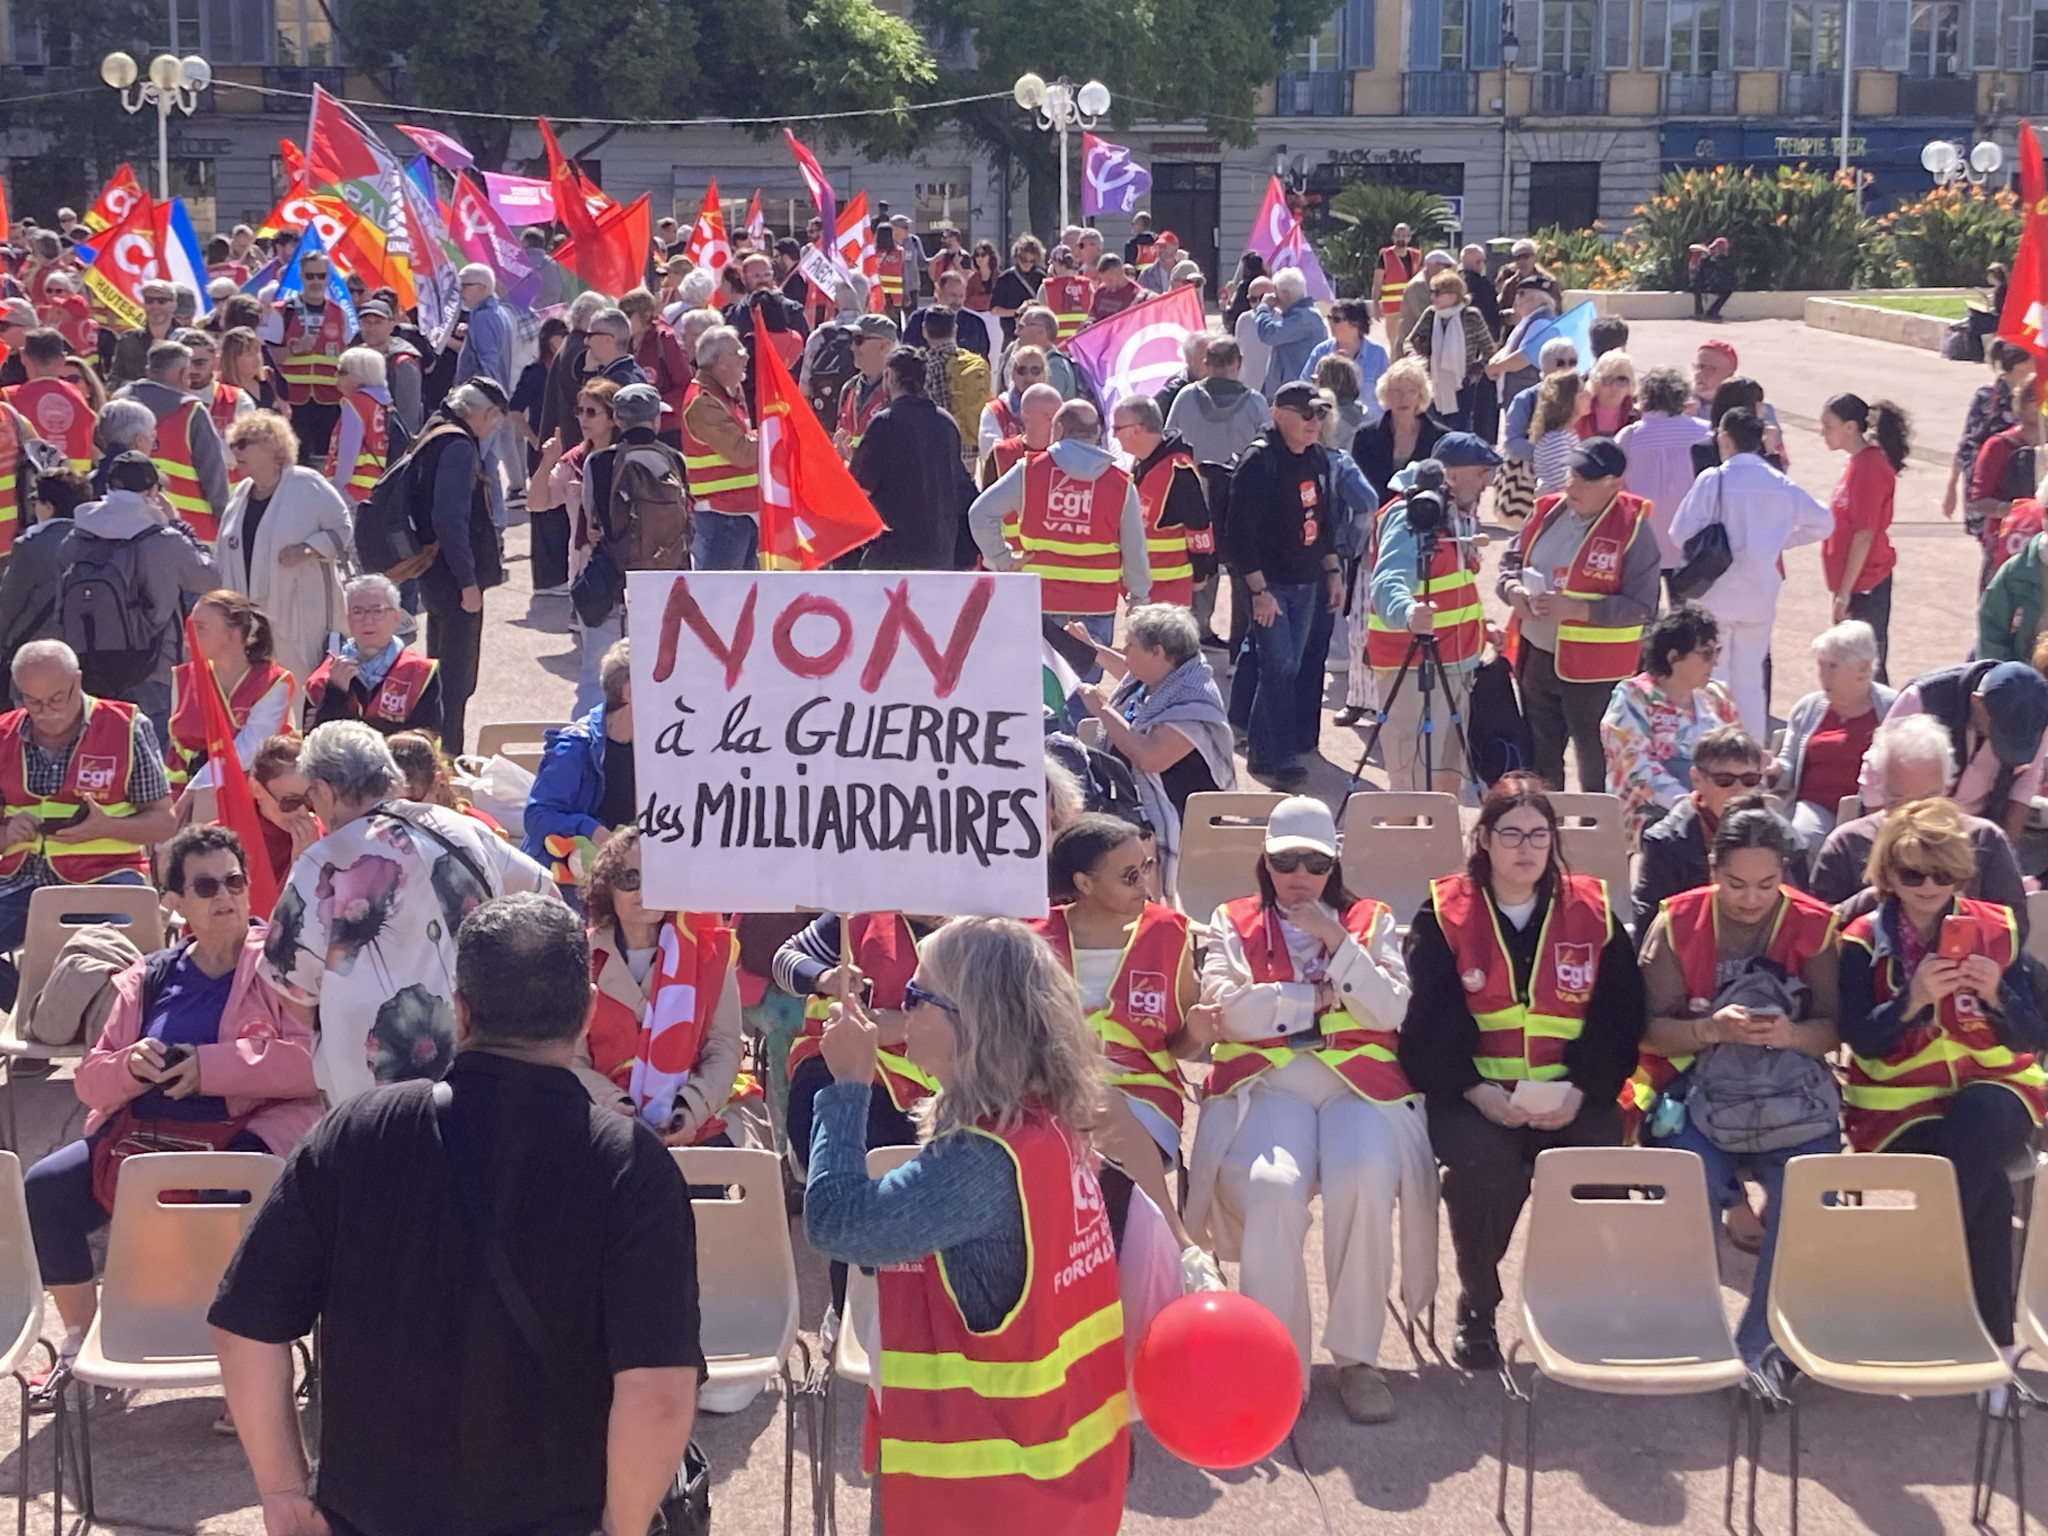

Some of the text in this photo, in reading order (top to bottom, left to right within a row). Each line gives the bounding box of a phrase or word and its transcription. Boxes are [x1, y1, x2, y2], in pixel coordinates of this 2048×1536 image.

[96, 279, 147, 327] HAUTES-A
[1049, 489, 1092, 518] cgt
[1042, 521, 1092, 535] VAR
[1582, 568, 1615, 581] VAR
[1587, 551, 1617, 570] cgt
[652, 575, 996, 698] NON
[380, 691, 407, 712] cgt
[655, 694, 1028, 769] à la GUERRE
[79, 768, 114, 788] cgt
[636, 792, 685, 843] des
[1557, 961, 1592, 988] cgt
[1053, 1236, 1116, 1294] FORCAL
